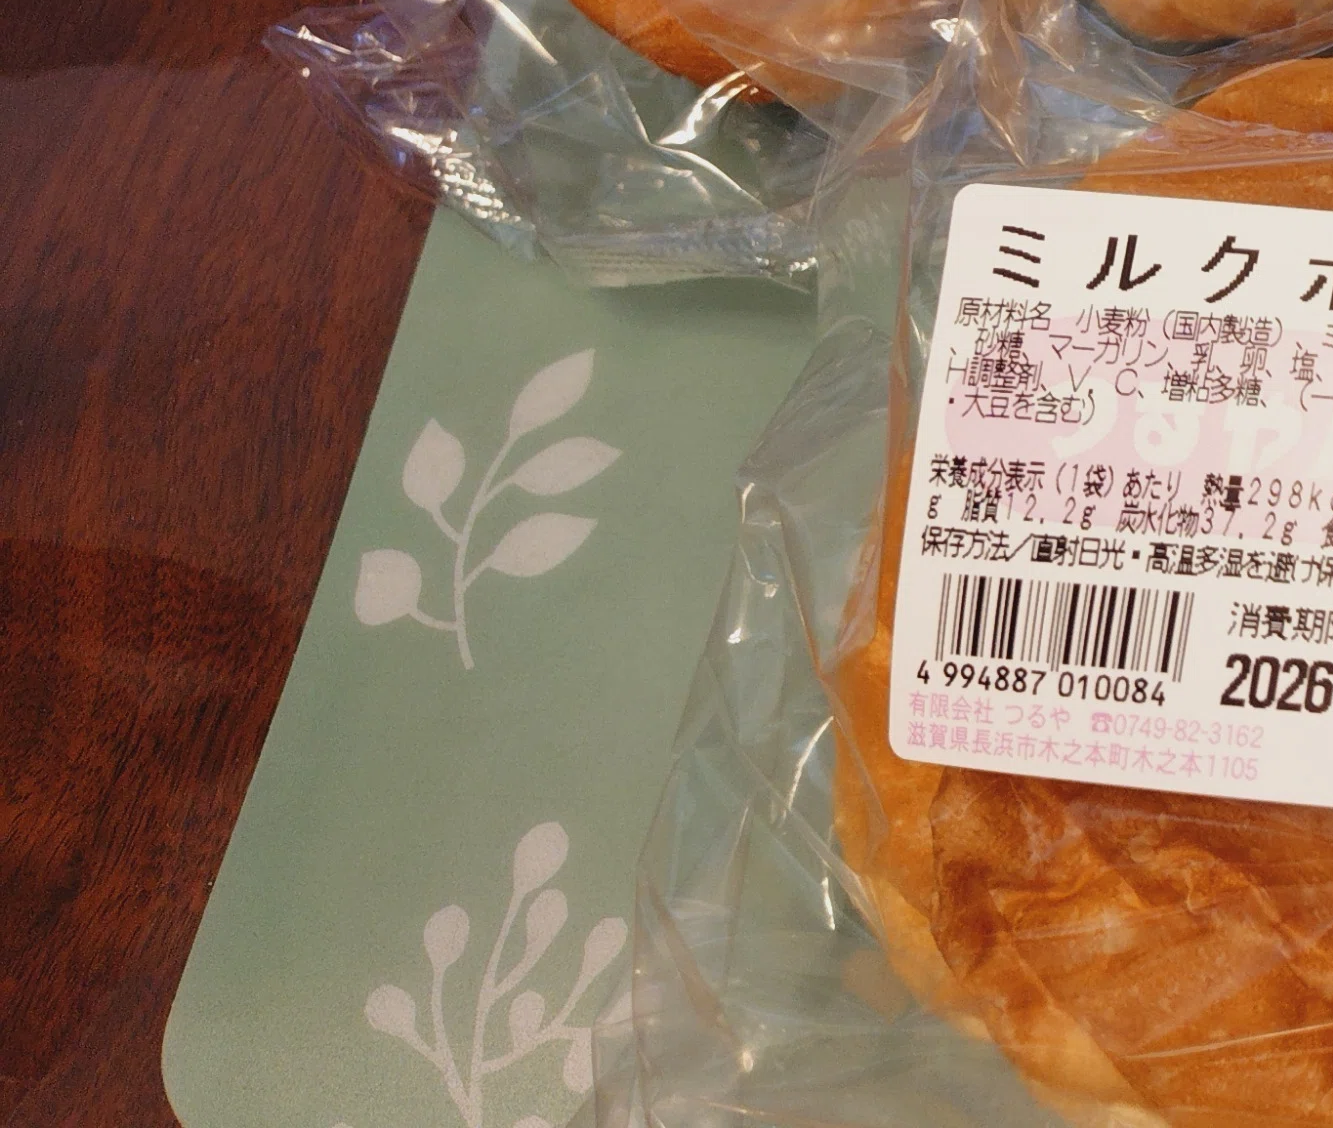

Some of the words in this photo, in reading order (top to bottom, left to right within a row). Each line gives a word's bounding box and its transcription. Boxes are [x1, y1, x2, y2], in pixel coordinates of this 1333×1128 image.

[954, 297, 1051, 331] 原材料名
[926, 493, 942, 520] g
[916, 660, 930, 685] 4
[943, 662, 1047, 695] 994887
[1058, 672, 1166, 707] 010084
[909, 690, 994, 724] 有限会社
[1004, 704, 1072, 730] つるや
[1113, 714, 1265, 749] 0749-82-3162
[907, 722, 1260, 781] 滋賀県長浜市木之本町木之本1105
